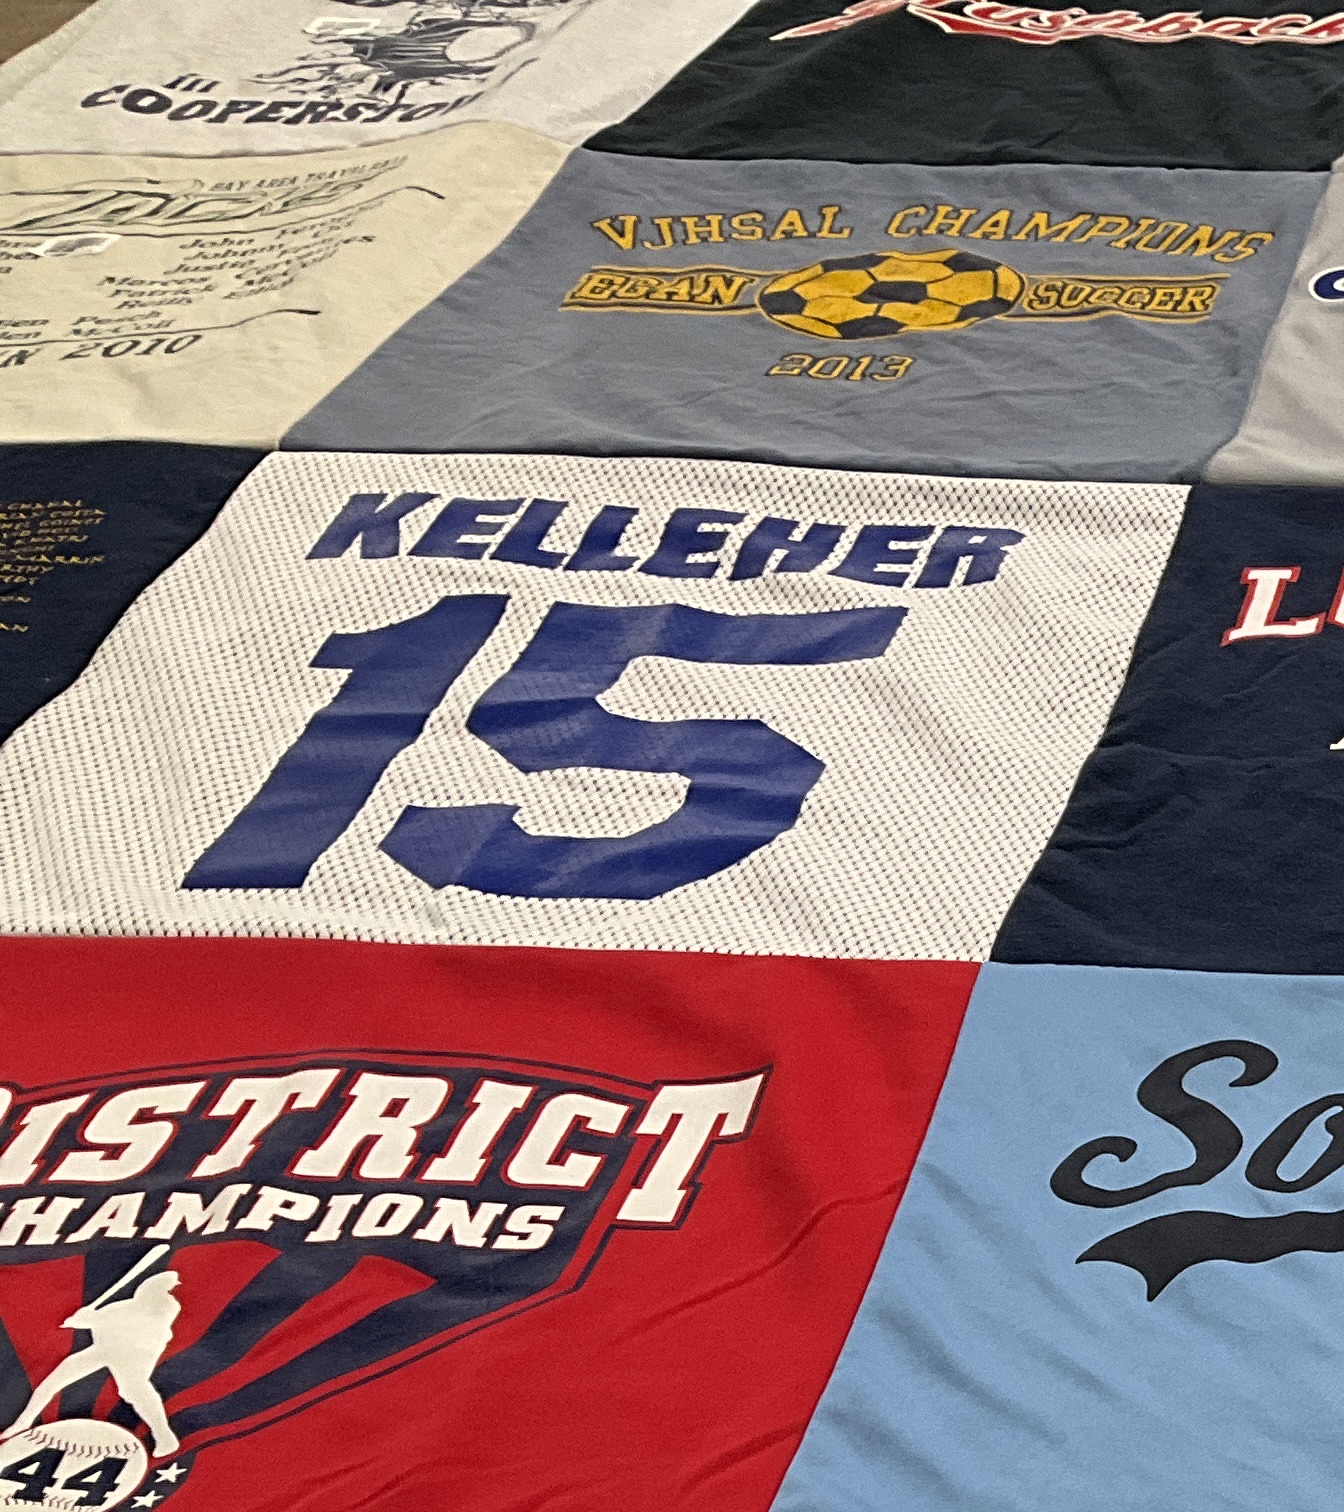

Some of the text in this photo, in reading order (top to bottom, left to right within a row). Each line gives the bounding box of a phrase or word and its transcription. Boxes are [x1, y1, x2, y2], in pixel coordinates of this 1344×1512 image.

[885, 203, 1276, 266] CHAMPIONS
[566, 272, 1220, 316] EGAN SOCCER
[59, 334, 203, 361] 2010
[766, 353, 916, 382] 2013
[305, 491, 1026, 589] KELLEHER
[180, 592, 909, 901] 15
[0, 1184, 566, 1251] HAMPIONS
[0, 1446, 129, 1507] 44
